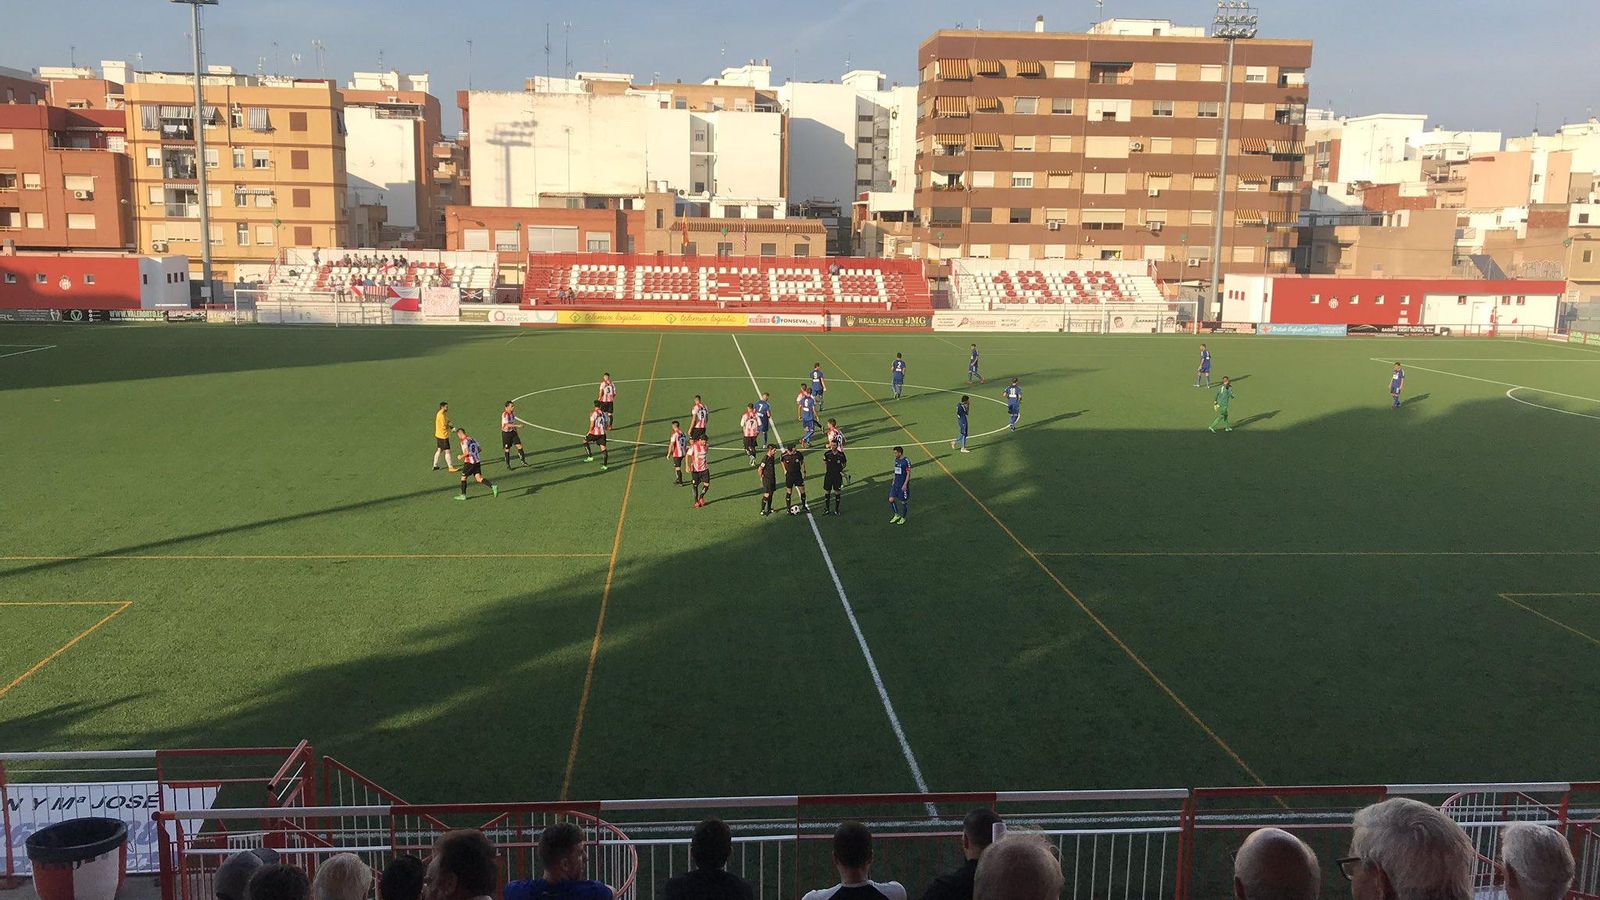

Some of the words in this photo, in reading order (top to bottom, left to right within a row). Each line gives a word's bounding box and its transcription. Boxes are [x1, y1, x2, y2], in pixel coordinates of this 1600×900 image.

[905, 316, 926, 325] JMG
[32, 798, 47, 811] Y
[91, 791, 159, 809] JOSÉ
